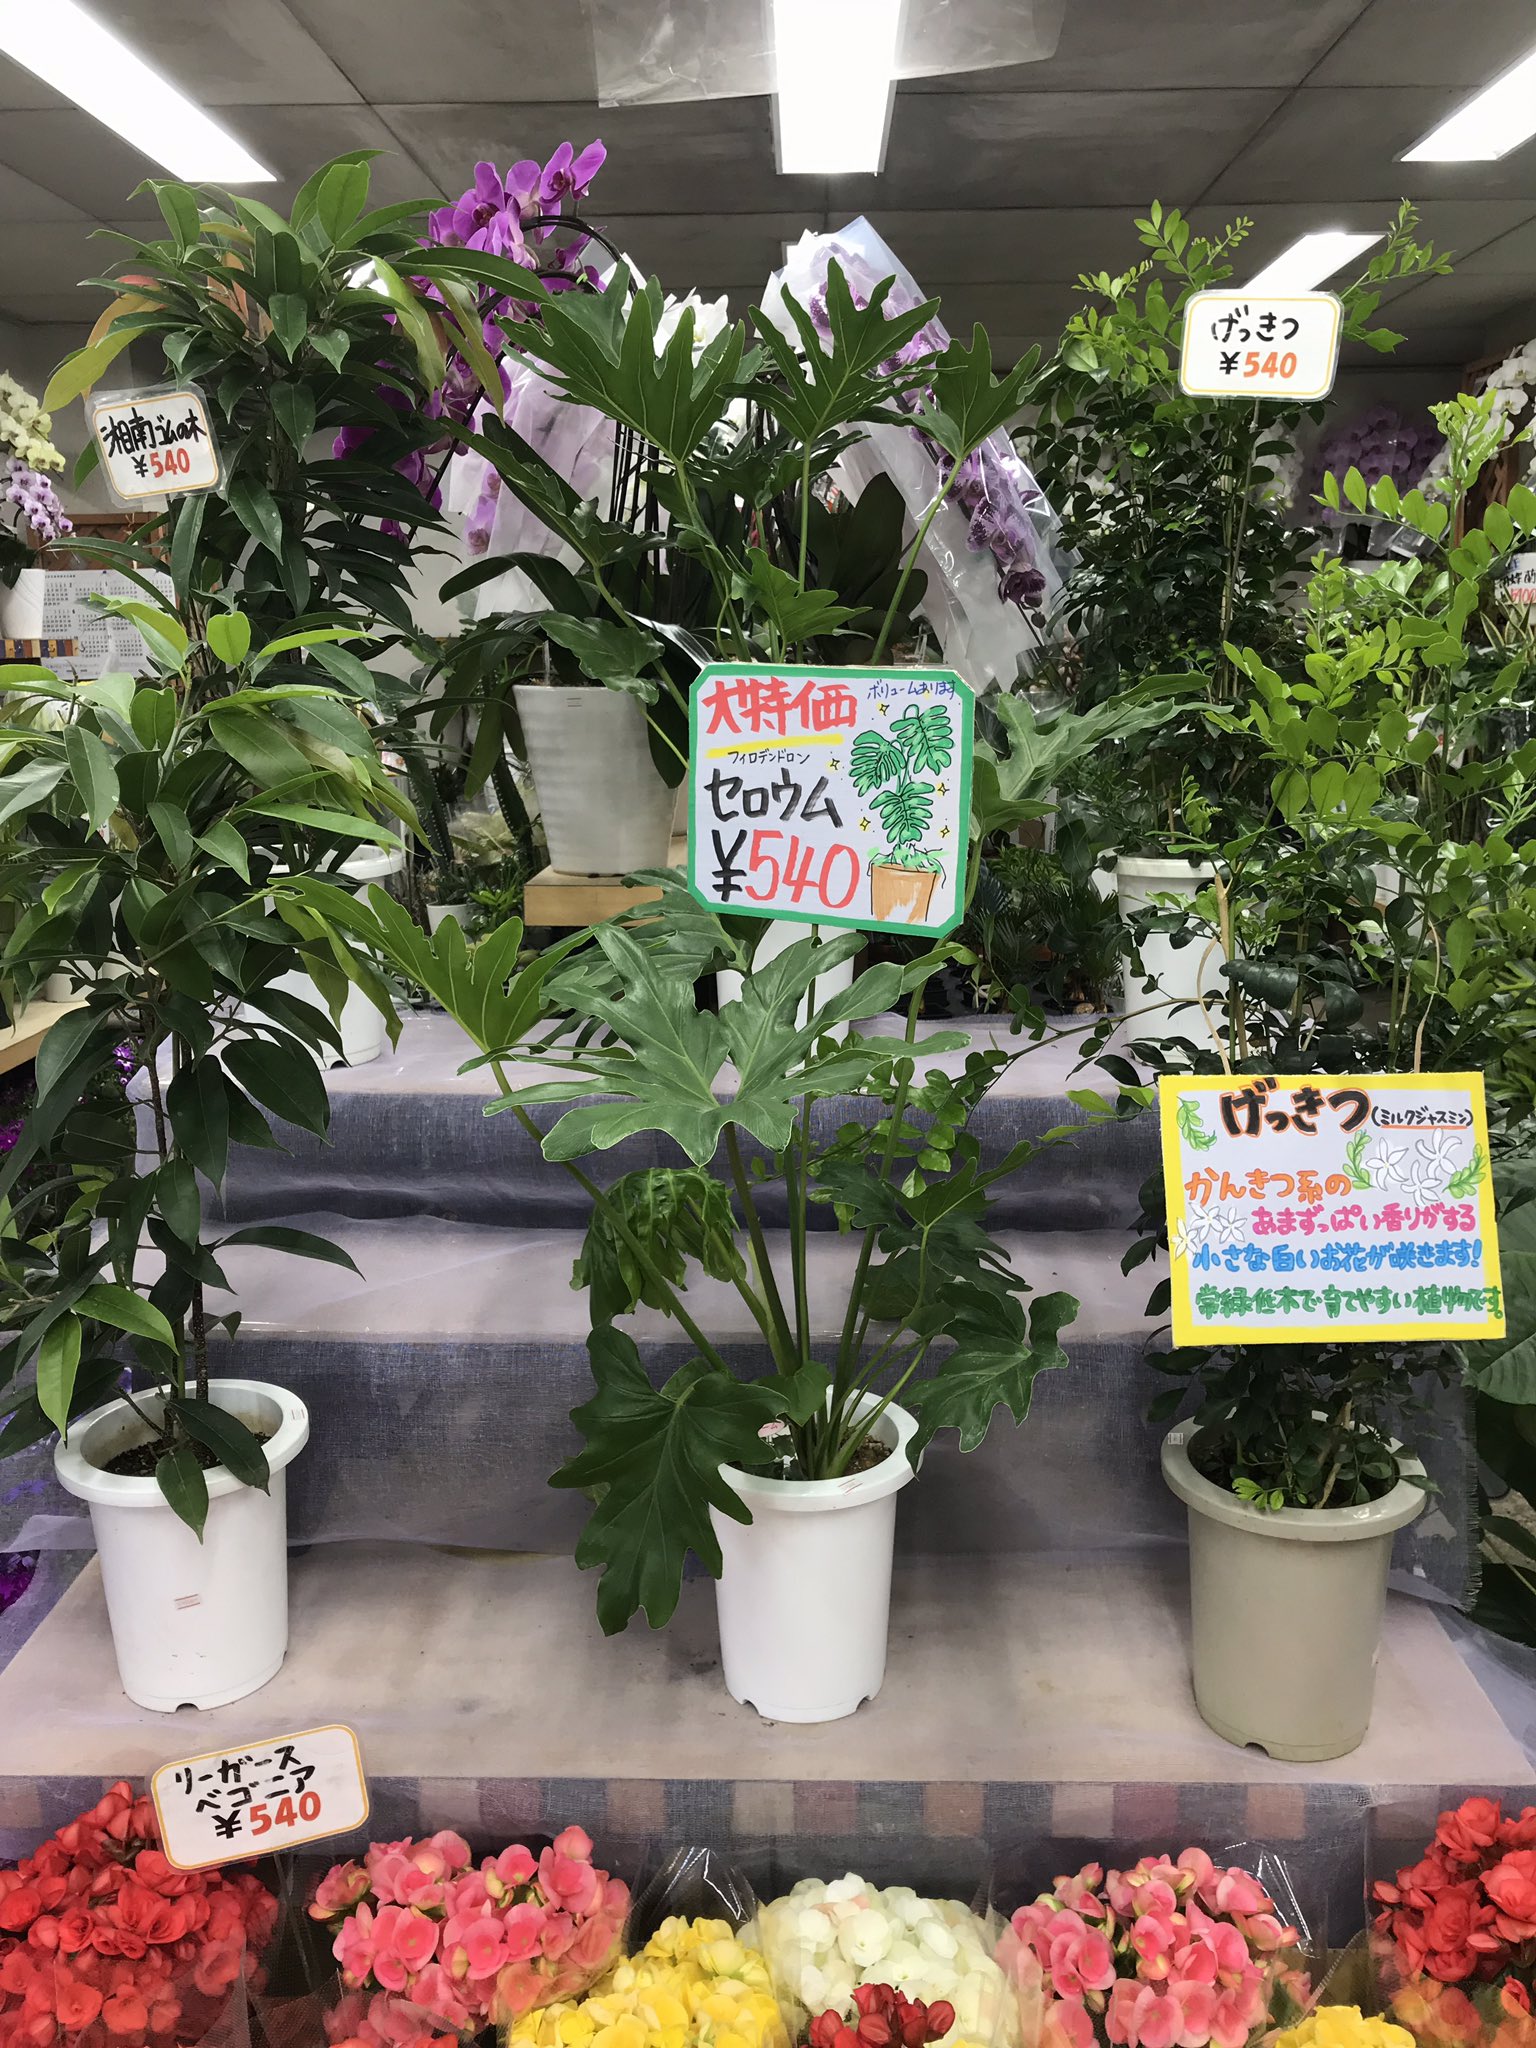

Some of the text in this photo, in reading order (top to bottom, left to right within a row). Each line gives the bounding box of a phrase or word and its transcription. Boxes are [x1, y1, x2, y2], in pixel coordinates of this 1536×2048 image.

[1211, 304, 1299, 343] げっきつ
[1219, 351, 1298, 379] ¥540
[100, 407, 207, 458] 湘南ゴムの木
[131, 447, 191, 478] ¥540
[702, 676, 858, 736] 大特価
[867, 679, 956, 700] ボリュームあります
[727, 747, 810, 766] フィロデンドロン
[704, 767, 843, 829] セロウム
[711, 829, 861, 909] ¥540
[1219, 1077, 1474, 1138] げっきつ (ミルクジャスミン)
[1184, 1167, 1352, 1206] かんきつ系の
[1251, 1202, 1476, 1236] あまずっぱい香りがする
[1191, 1238, 1483, 1273] 小さな白いお花が咲きます!
[1196, 1283, 1504, 1320] 常緑低木で育てやすい植物です。
[175, 1745, 302, 1795] リーガース
[195, 1765, 316, 1813] ベゴニア
[211, 1791, 322, 1839] ¥540
